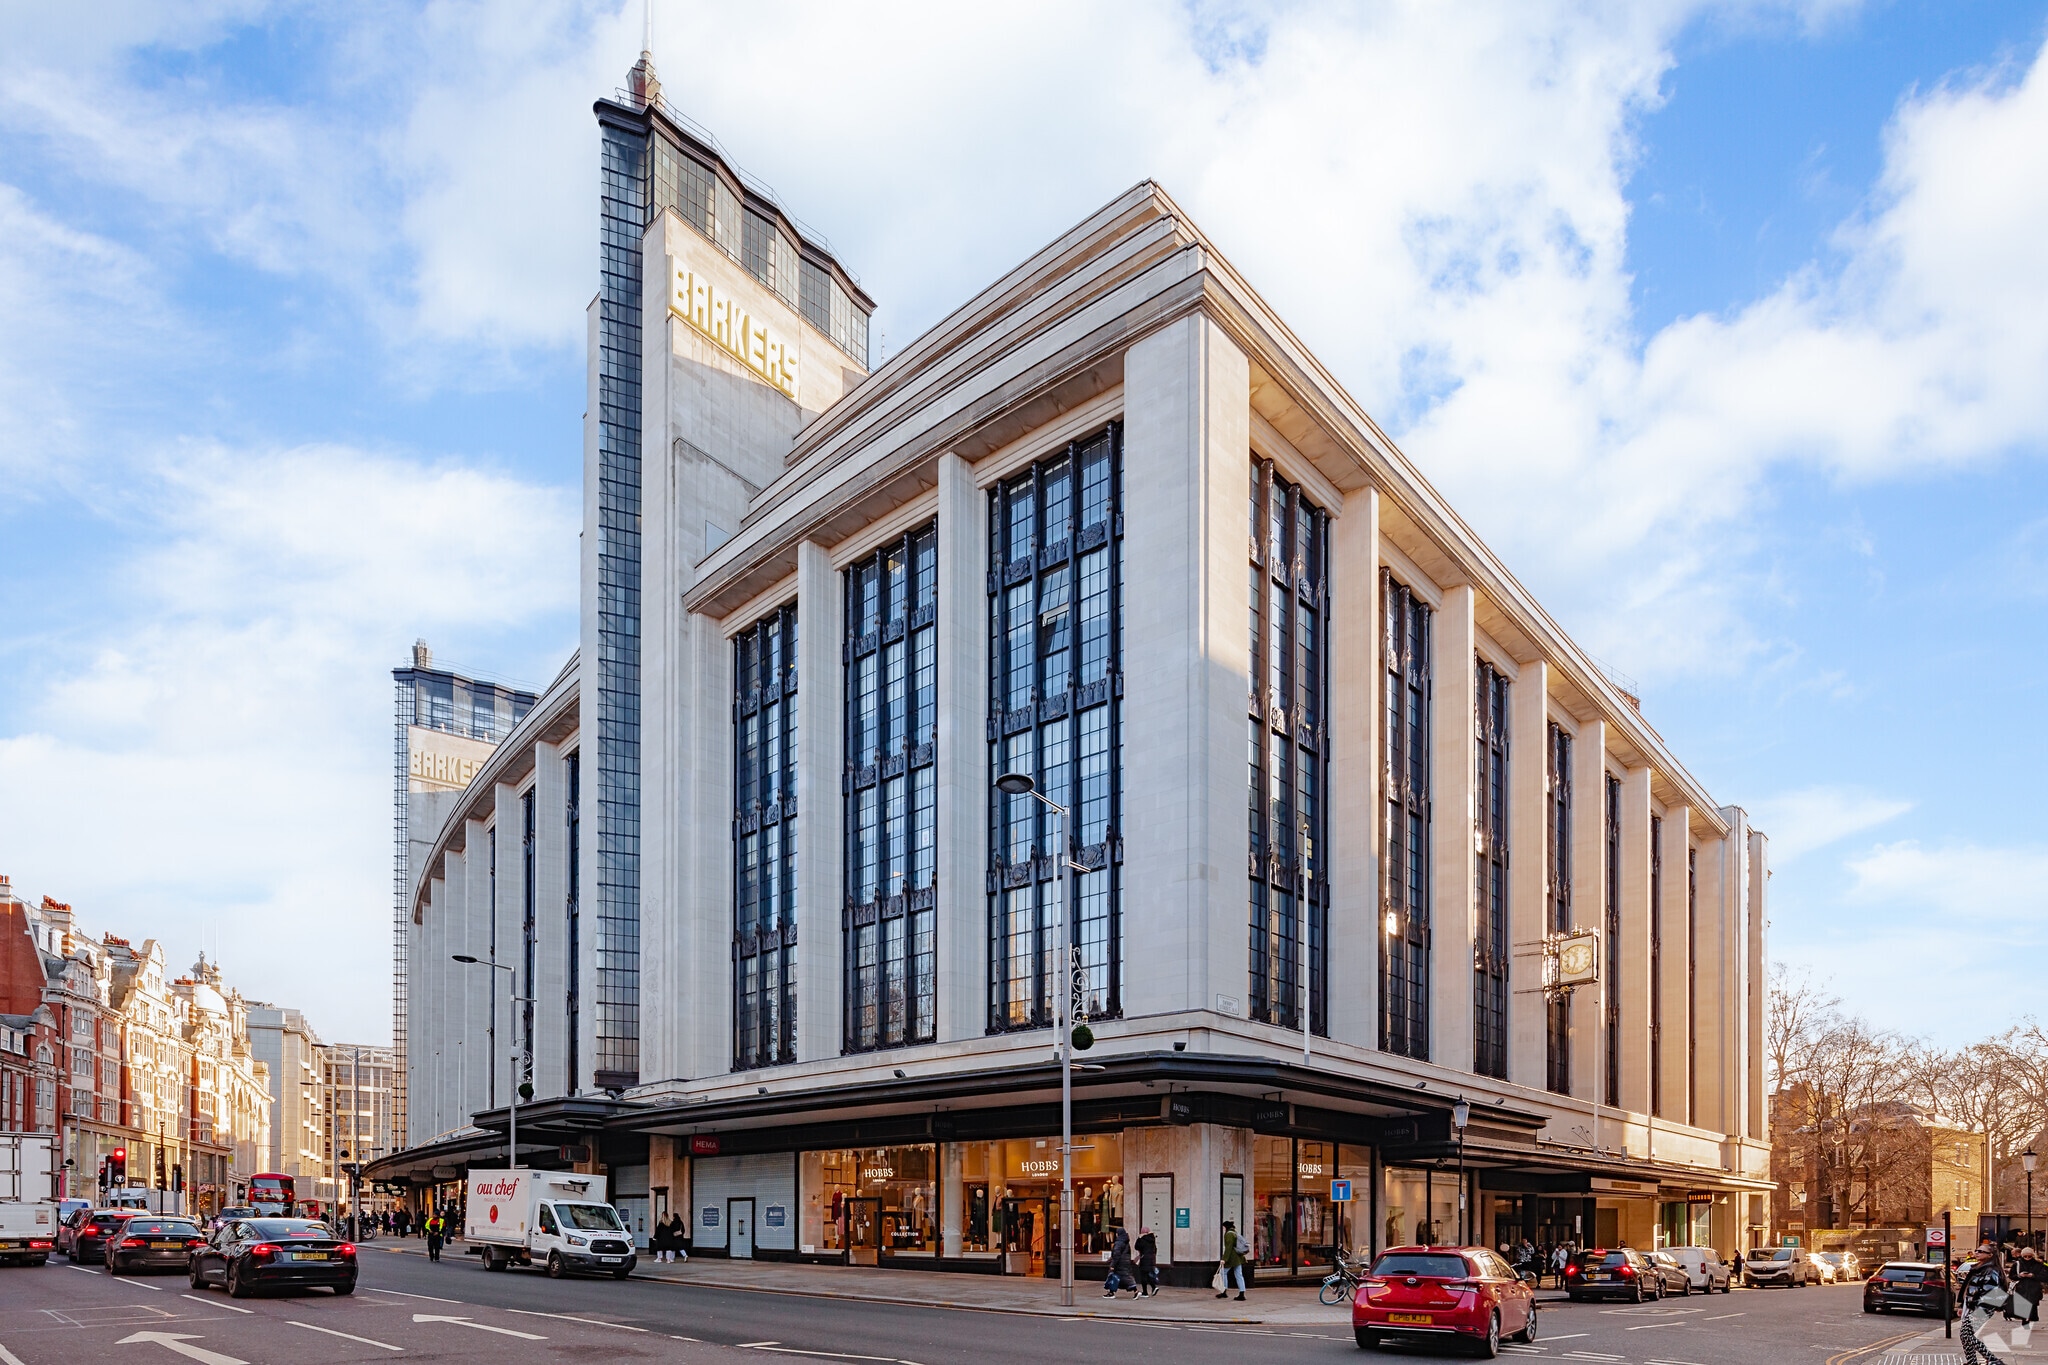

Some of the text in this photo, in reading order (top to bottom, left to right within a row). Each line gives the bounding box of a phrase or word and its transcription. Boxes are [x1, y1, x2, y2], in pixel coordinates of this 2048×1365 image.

[671, 255, 799, 398] BARKERS
[1172, 1103, 1190, 1114] HOBBS
[1256, 1110, 1284, 1120] HOBBS
[695, 1140, 717, 1149] HEMA
[1021, 1160, 1059, 1172] HOBBS
[864, 1168, 894, 1178] HOBBS
[495, 1177, 520, 1201] chef
